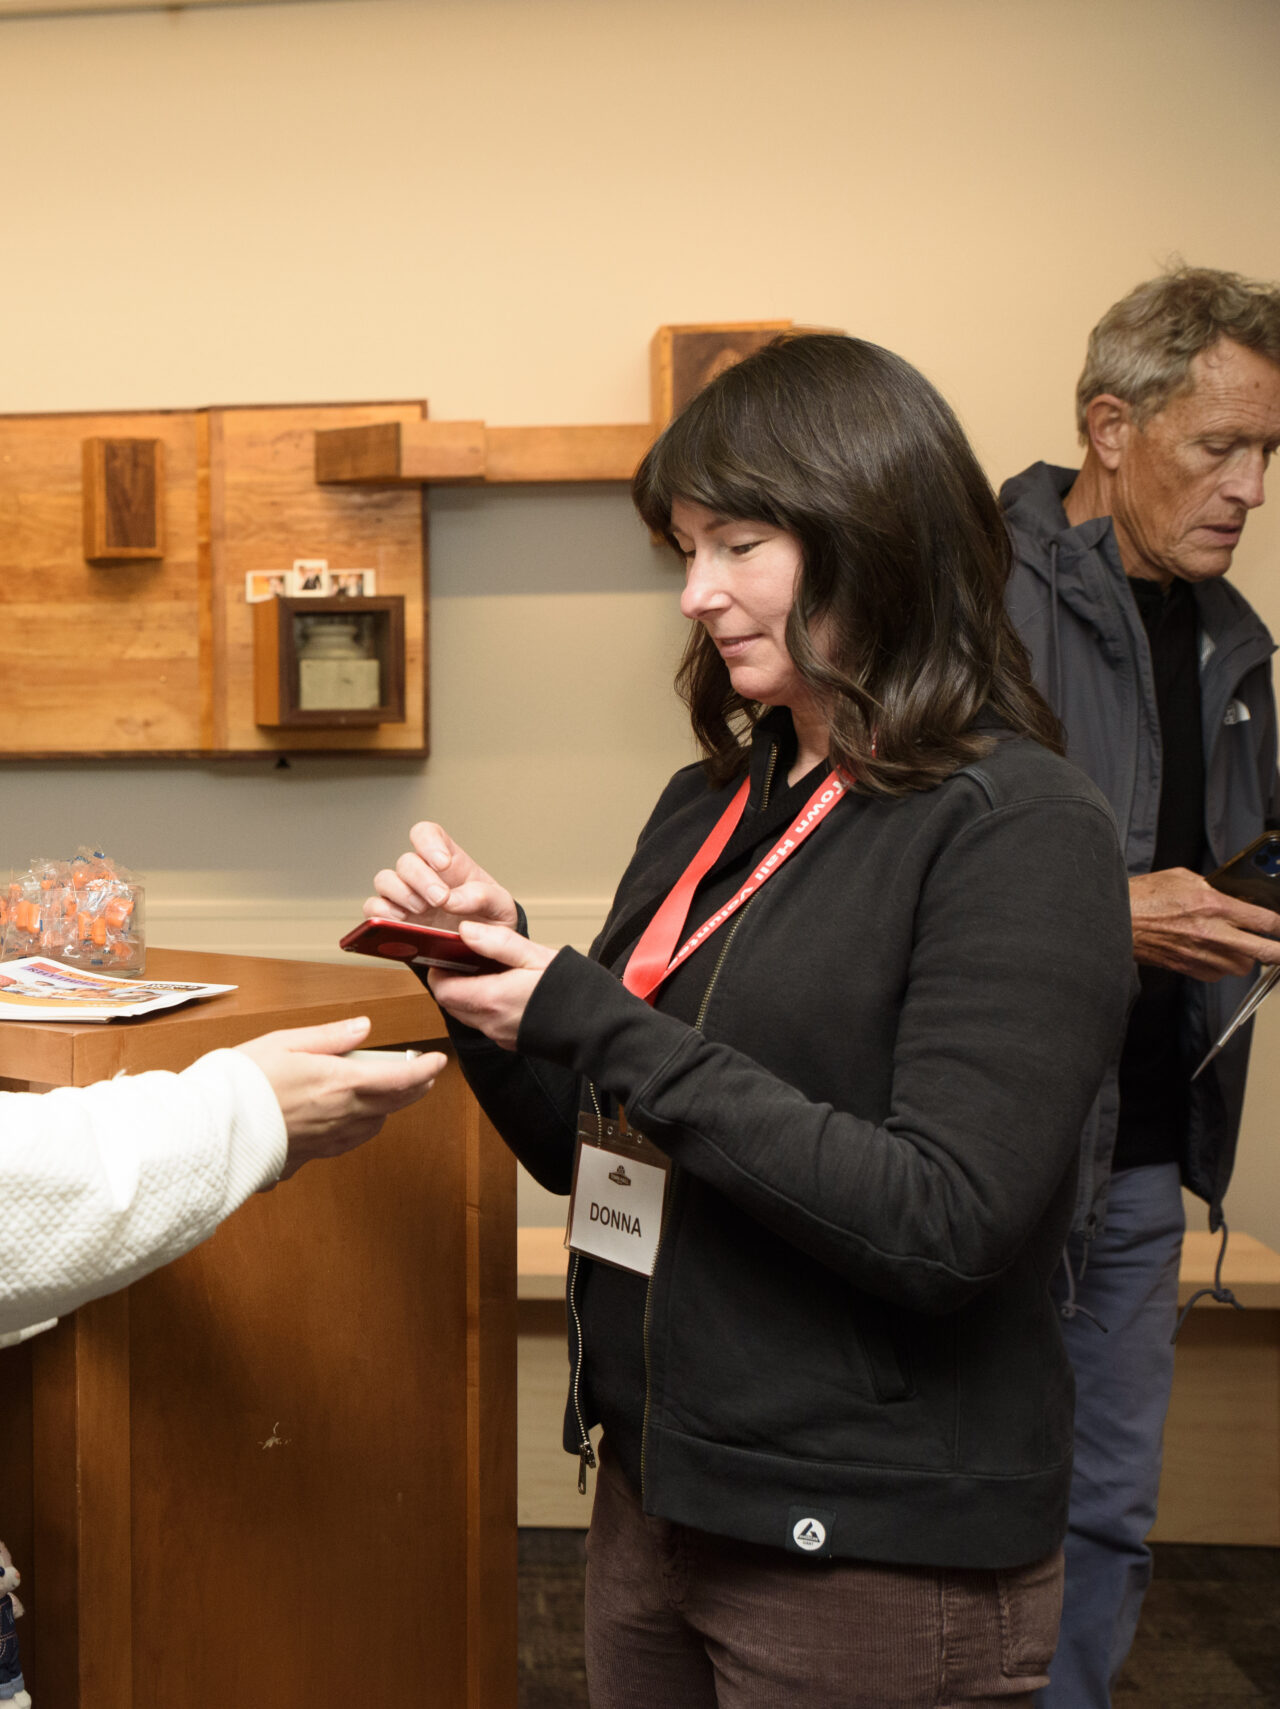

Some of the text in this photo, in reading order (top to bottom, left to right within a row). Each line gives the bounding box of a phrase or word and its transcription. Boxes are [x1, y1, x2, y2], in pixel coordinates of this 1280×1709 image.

[794, 779, 848, 833] Town
[754, 839, 795, 881] Hall
[589, 1201, 643, 1238] DONNA
